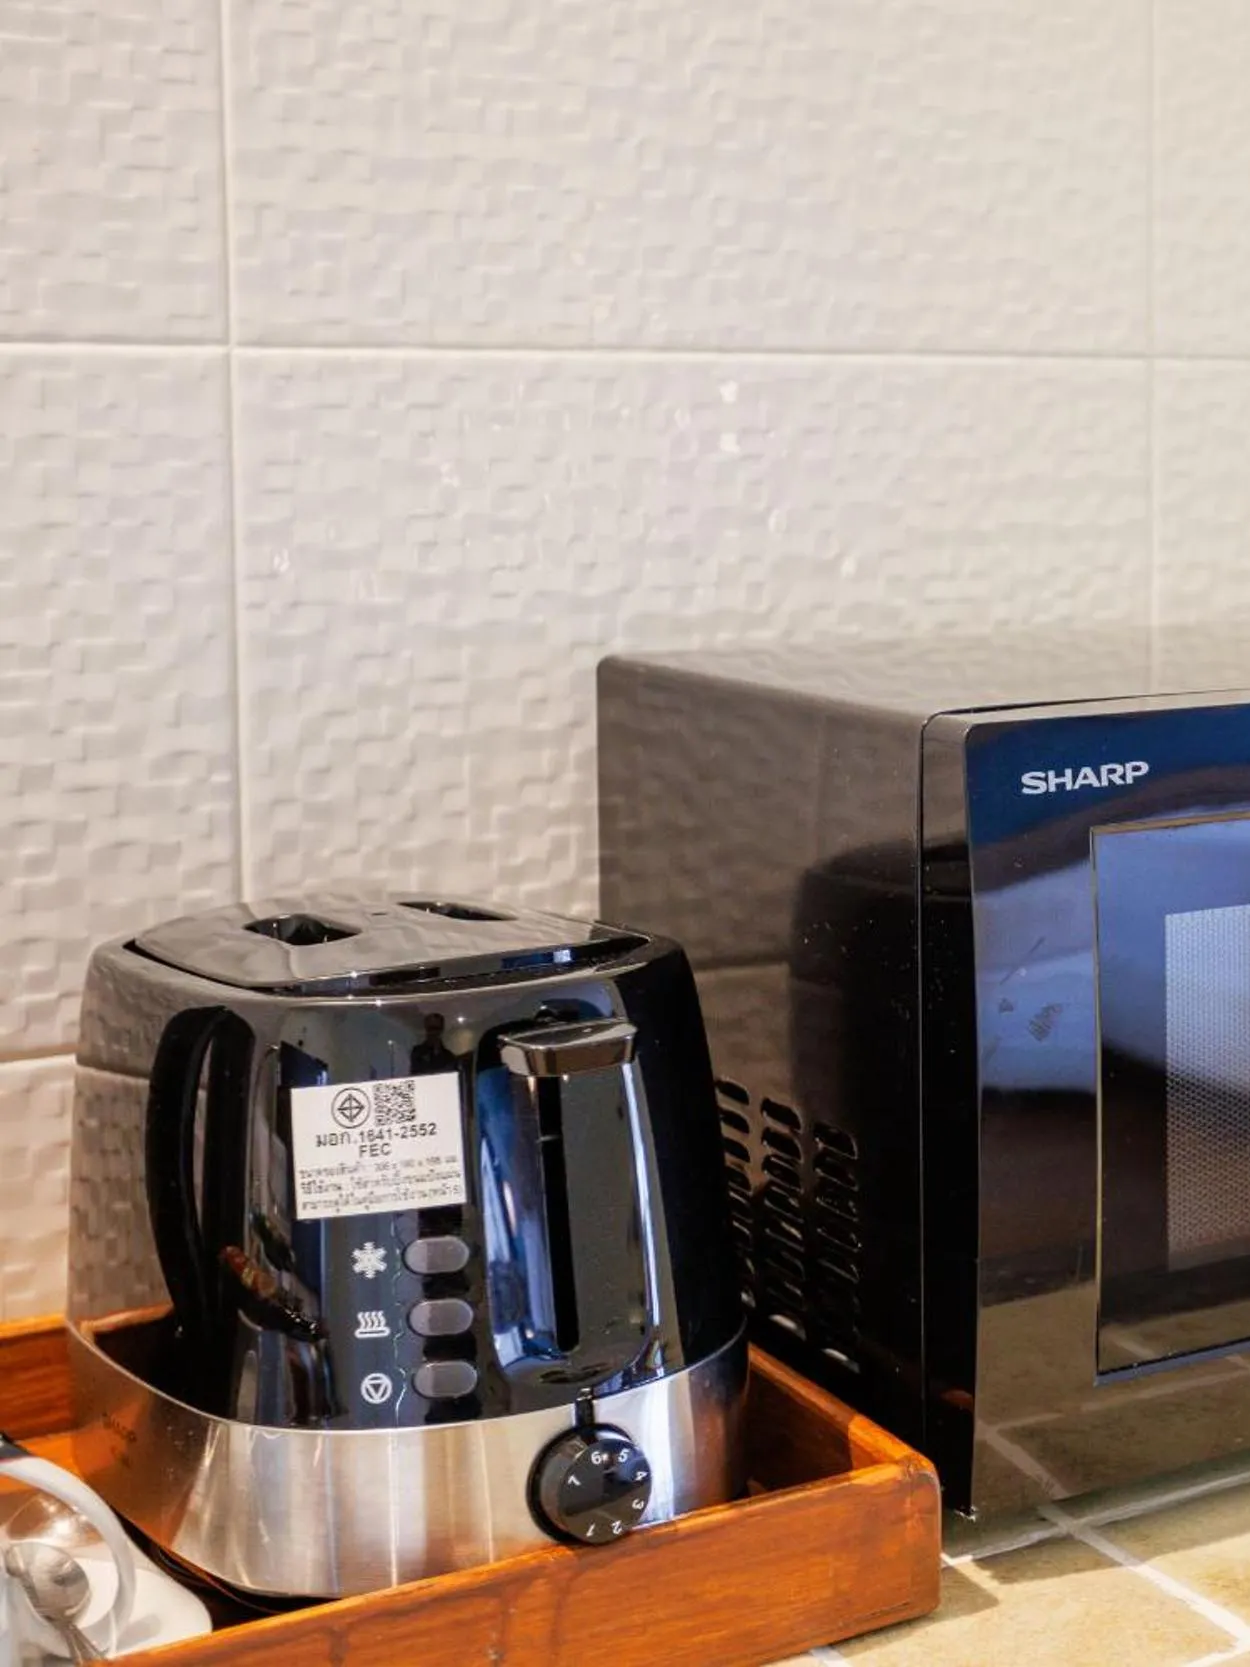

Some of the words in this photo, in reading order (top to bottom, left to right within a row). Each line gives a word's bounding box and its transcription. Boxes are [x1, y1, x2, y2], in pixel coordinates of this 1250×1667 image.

[1021, 760, 1149, 795] SHARP
[358, 1143, 392, 1158] FEC
[590, 1451, 601, 1465] 6
[618, 1449, 630, 1463] 5
[635, 1471, 649, 1481] 4
[632, 1499, 645, 1510] 3
[586, 1524, 596, 1537] 1
[610, 1520, 623, 1535] 2
